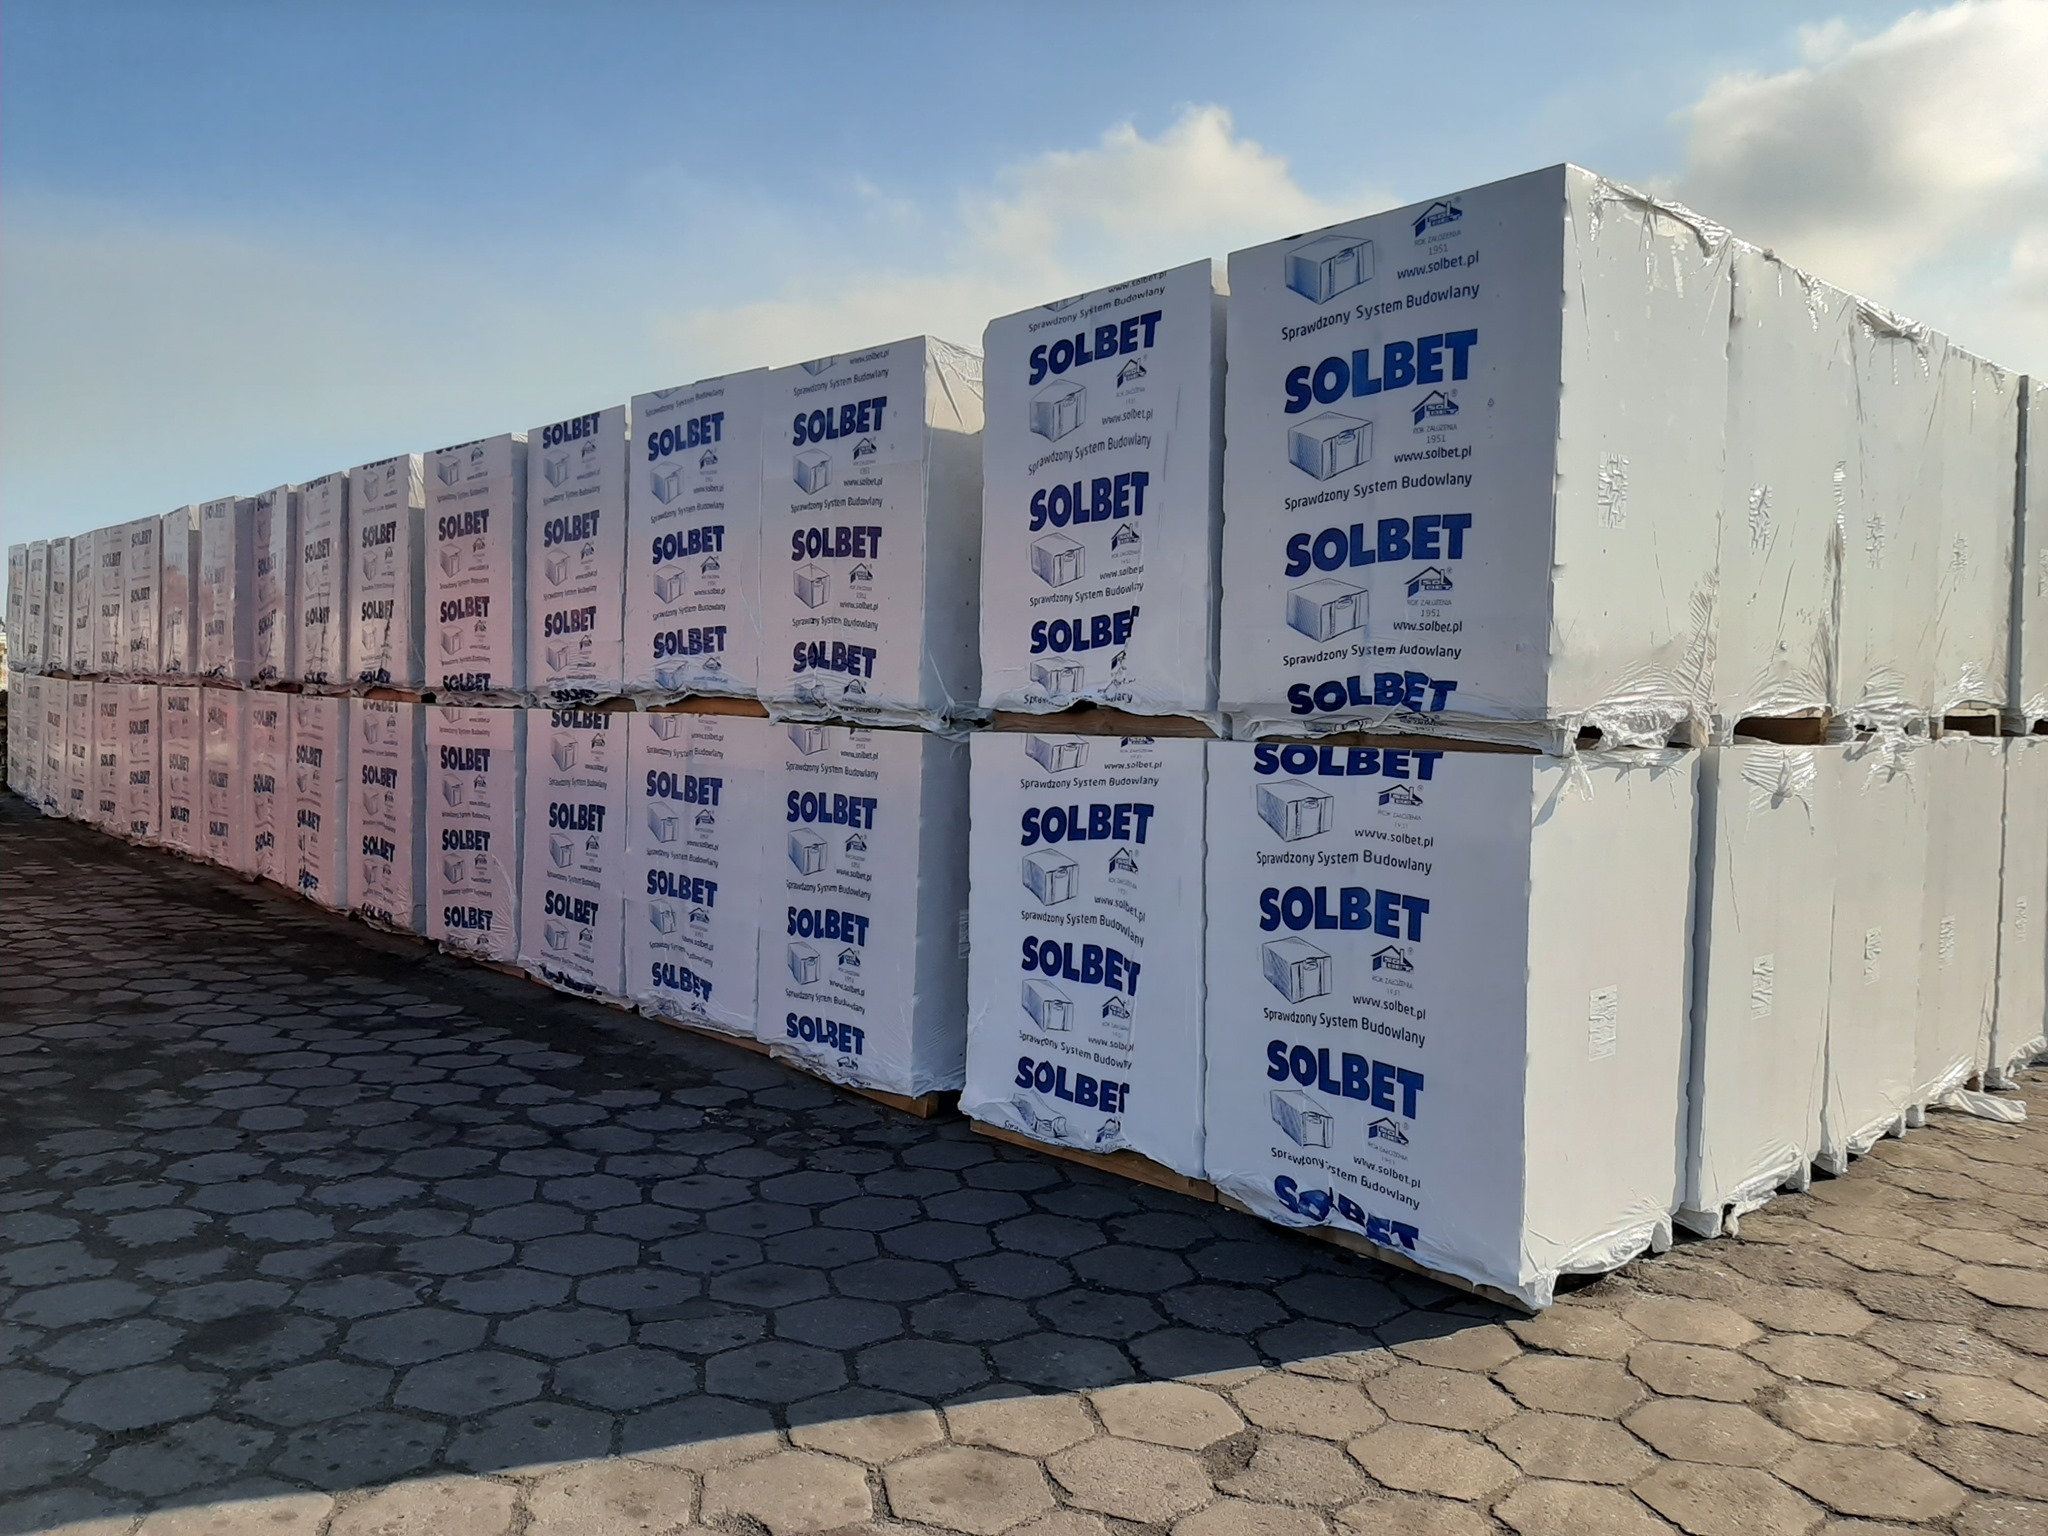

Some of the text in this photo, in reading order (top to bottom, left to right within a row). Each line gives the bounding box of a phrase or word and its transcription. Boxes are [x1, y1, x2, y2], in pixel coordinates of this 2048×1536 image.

[1397, 251, 1479, 280] www.solbet.pl
[1428, 244, 1448, 256] 1951
[1028, 286, 1165, 333] Sprawdzony System Budowlany
[1281, 283, 1480, 342] Sprawdzony System Budowlany
[1029, 310, 1162, 386] SOLBET
[794, 368, 889, 396] Sprawdzony System Budowlany
[1284, 328, 1478, 414] SOLBET
[542, 412, 600, 449] SOLBET
[792, 396, 887, 446] SOLBET
[1102, 408, 1153, 425] www.solbet.pl
[648, 411, 724, 462] SOLBET
[1427, 434, 1445, 444] 1951
[1028, 433, 1151, 476] Sprawdzony System Budowlany
[1394, 445, 1472, 463] www.solbet.pl
[790, 496, 883, 513] Sprawdzony System Budowlany
[1029, 471, 1149, 532] SOLBET
[1284, 473, 1472, 512] Sprawdzony System Budowlany
[362, 521, 396, 549] SOLBET
[439, 509, 489, 541] SOLBET
[544, 510, 600, 548] SOLBET
[652, 525, 725, 565] SOLBET
[791, 526, 882, 562] SOLBET
[1285, 513, 1472, 576] SOLBET
[1100, 565, 1144, 581] www.solbepl
[440, 596, 490, 623] SOLBET
[1030, 590, 1103, 607] Sprawdzony System
[1421, 609, 1440, 617] 1951
[544, 606, 596, 638] SOLBET
[1393, 621, 1462, 634] www.solbet.pl
[653, 626, 727, 659] SOLBET
[1283, 649, 1348, 667] Sprawdzony
[1351, 645, 1395, 656] System
[793, 641, 877, 678] SOLBET
[1287, 670, 1458, 715] SOLBET
[551, 710, 612, 730] SOLBET
[441, 745, 490, 772] SOLBET
[786, 761, 878, 780] Sprawdzony System Budowlany
[1104, 761, 1162, 770] www.solbet.pl
[1253, 743, 1443, 780] SOLBET
[362, 765, 397, 789] SOLBET
[646, 770, 723, 806] SOLBET
[1020, 776, 1159, 790] Sprawdzony System Budowlany
[549, 802, 606, 832] SOLBET
[786, 790, 877, 829] SOLBET
[1021, 803, 1154, 847] SOLBET
[442, 829, 490, 851] SOLBET
[1354, 829, 1434, 848] www.solbet.pl
[1256, 849, 1432, 876] Sprawdzony System Budowlany
[647, 869, 718, 908] SOLBET
[444, 906, 493, 931] SOLBET
[544, 890, 598, 926] SOLBET
[1094, 896, 1145, 924] www.solbet.pl
[1259, 886, 1430, 942] SOLBET
[787, 906, 869, 947] SOLBET
[1021, 910, 1144, 948] Sprawdzony System Budowlany
[1021, 935, 1141, 996] SOLBET
[1353, 995, 1426, 1020] www.solbet.pl
[786, 1012, 865, 1055] SOLBET
[1263, 1007, 1425, 1048] Sprawdzony System Budowlany
[1061, 1042, 1091, 1060] System
[1267, 1039, 1424, 1120] SOLBET
[1353, 1156, 1421, 1188] www.solbet.pl
[1360, 1175, 1420, 1210] Budowlany
